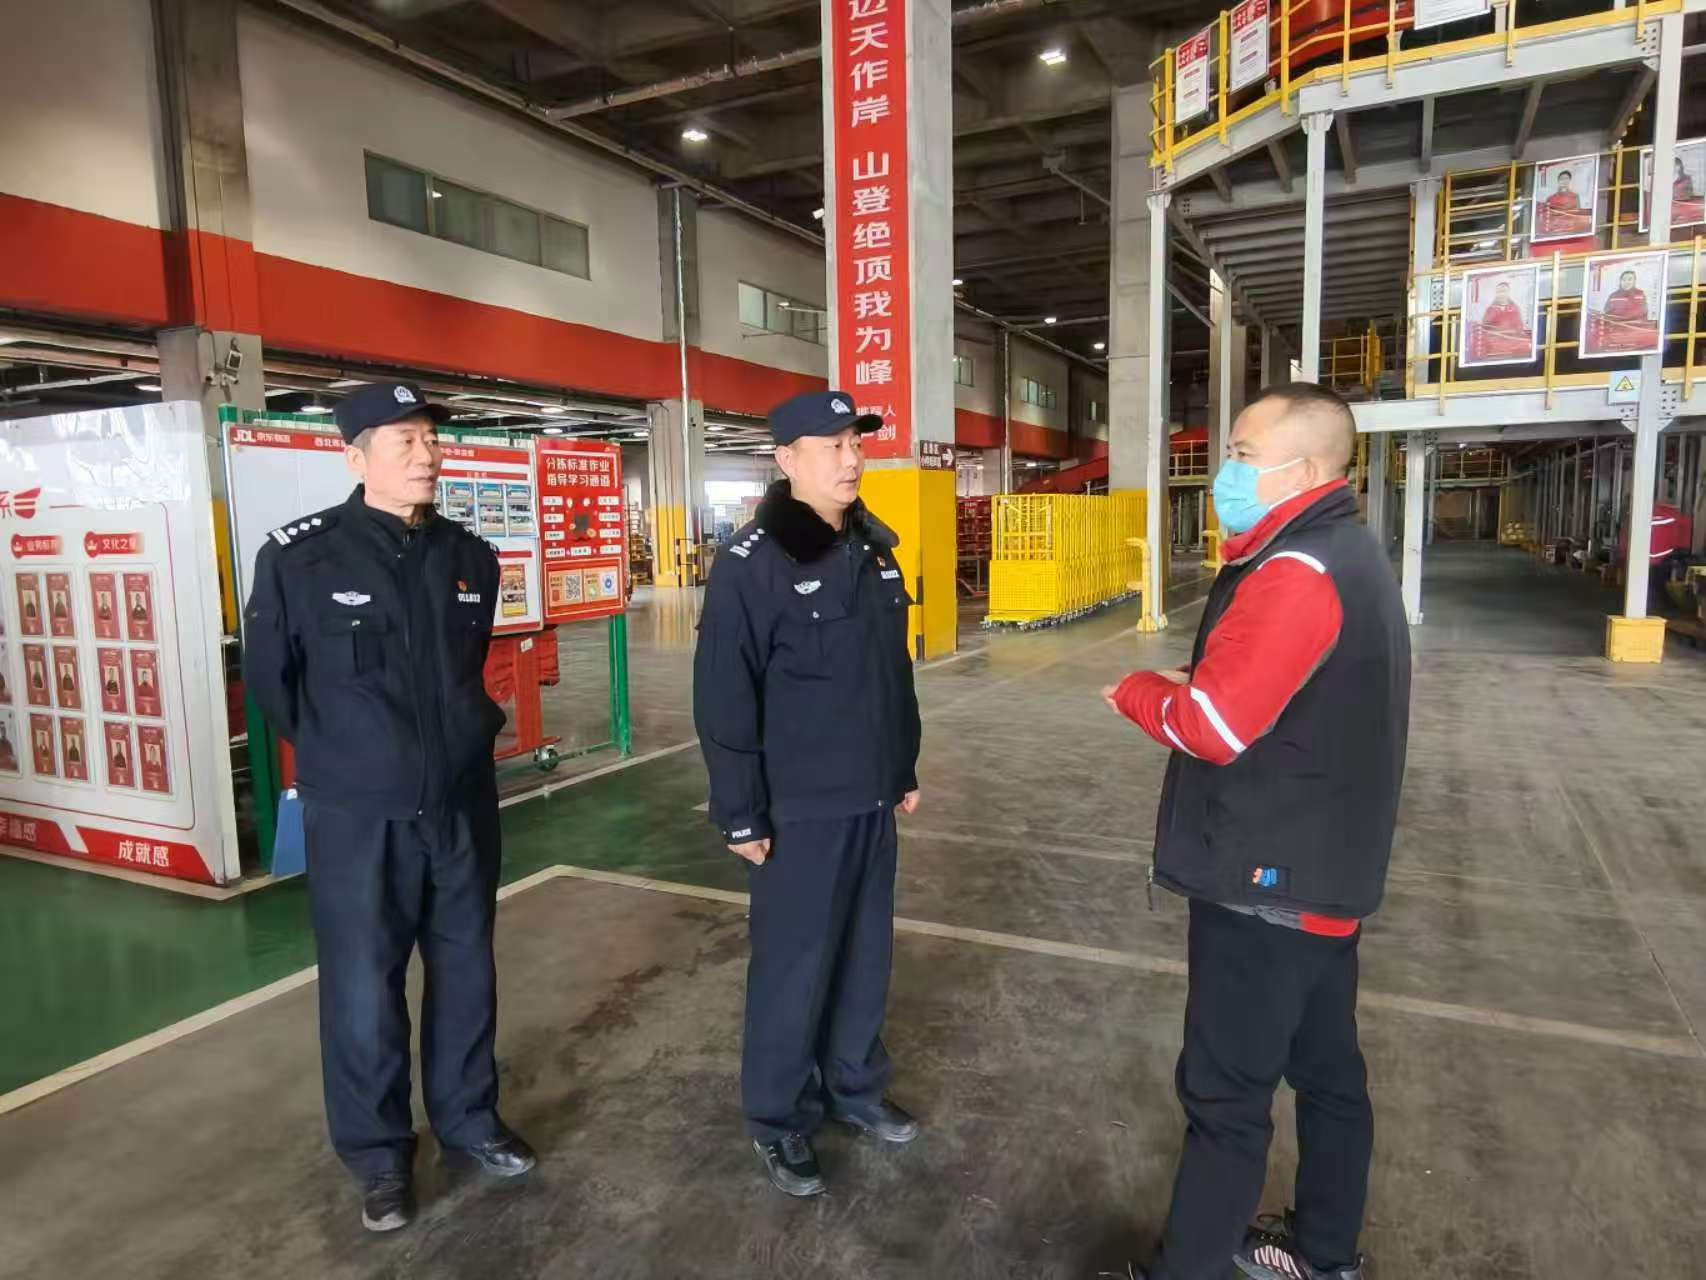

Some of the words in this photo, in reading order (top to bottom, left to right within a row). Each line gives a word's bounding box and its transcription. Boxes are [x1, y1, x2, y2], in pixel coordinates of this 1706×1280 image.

[852, 151, 893, 386] 山登绝顶我为峰
[233, 429, 256, 443] JDL
[118, 840, 169, 867] 成就感
